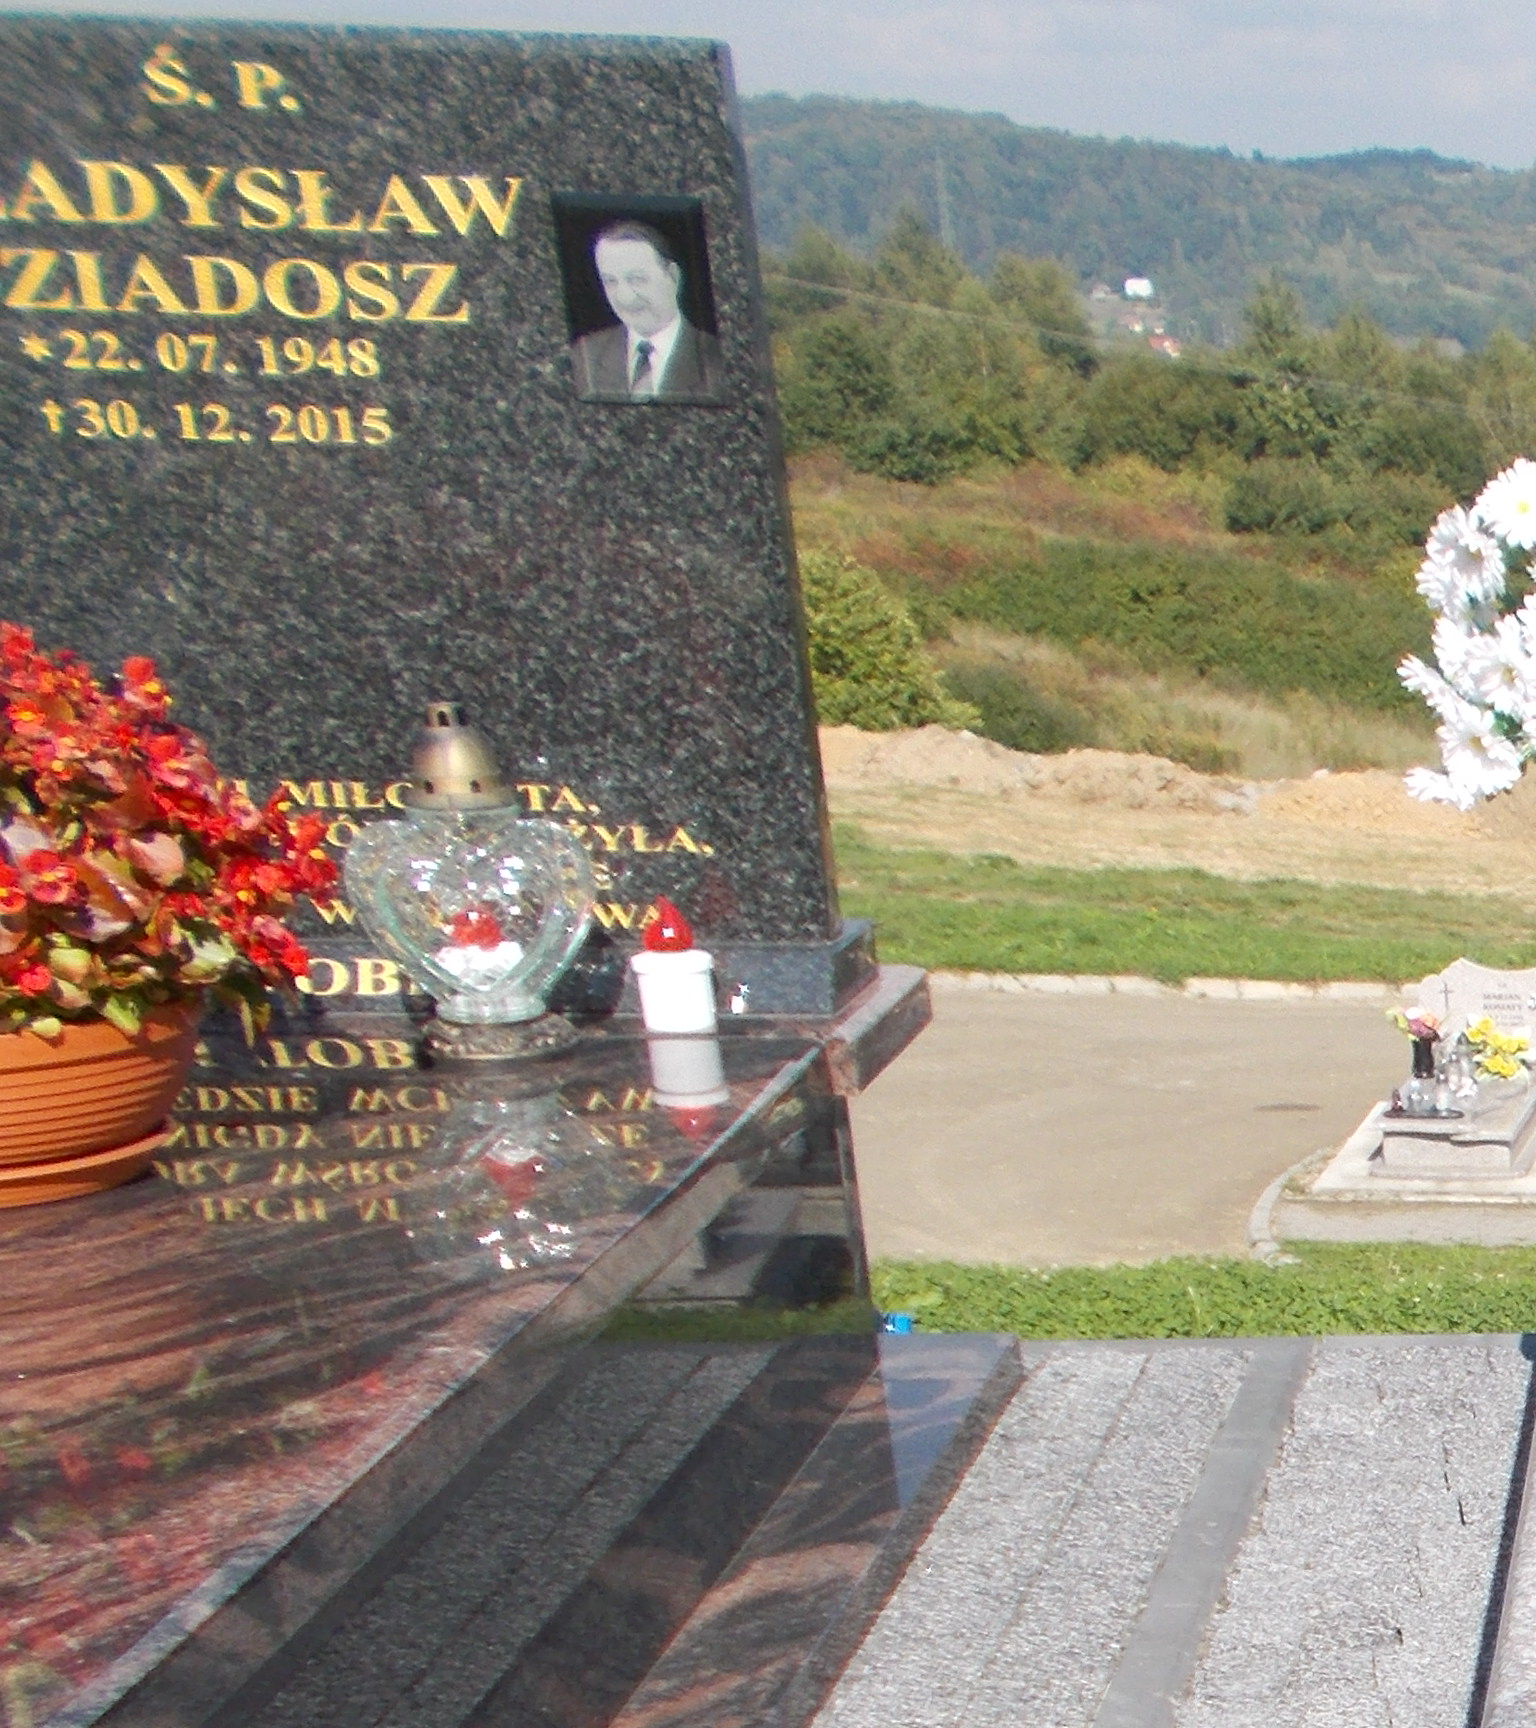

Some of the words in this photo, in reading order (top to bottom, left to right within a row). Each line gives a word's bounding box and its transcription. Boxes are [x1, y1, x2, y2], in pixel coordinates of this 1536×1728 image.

[142, 42, 215, 108] Ś.
[231, 60, 301, 113] P.
[0, 156, 525, 238] ADYSŁAW
[154, 332, 238, 376] 07.
[256, 336, 382, 379] 1948
[172, 402, 251, 444] 12.
[264, 404, 394, 446] 2015
